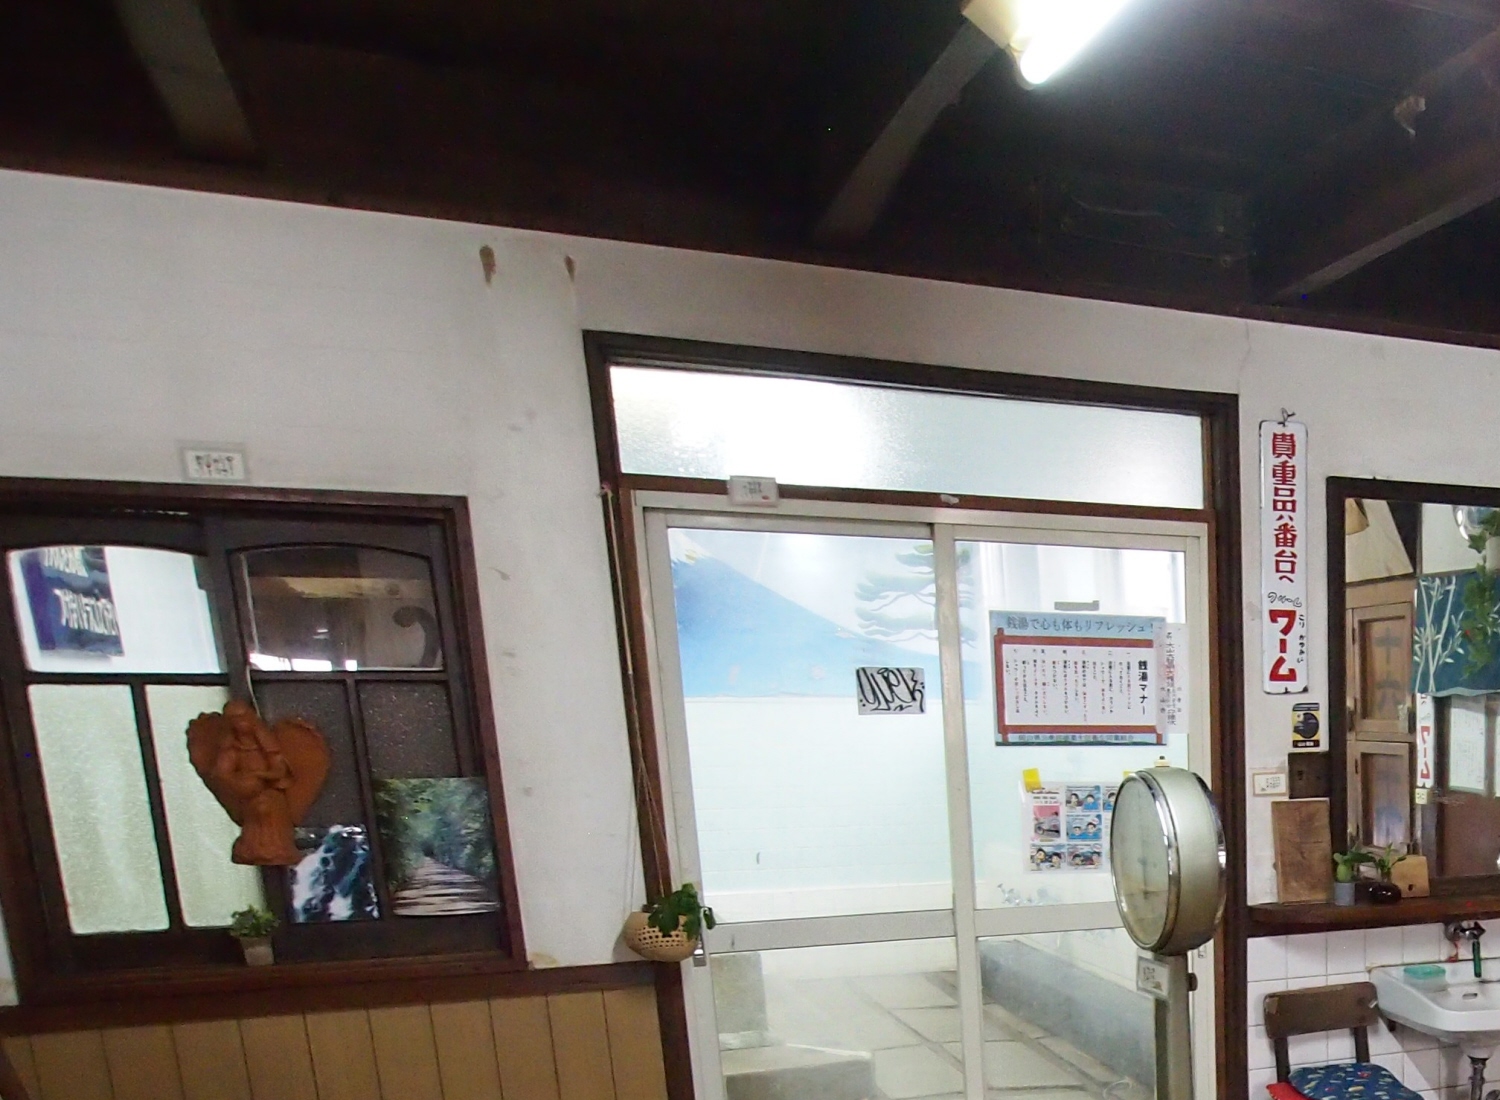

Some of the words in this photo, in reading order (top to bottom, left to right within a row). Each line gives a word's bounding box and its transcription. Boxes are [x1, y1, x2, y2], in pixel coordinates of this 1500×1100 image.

[1269, 609, 1297, 682] ワーム
[1137, 659, 1149, 716] 銭湯マナー
